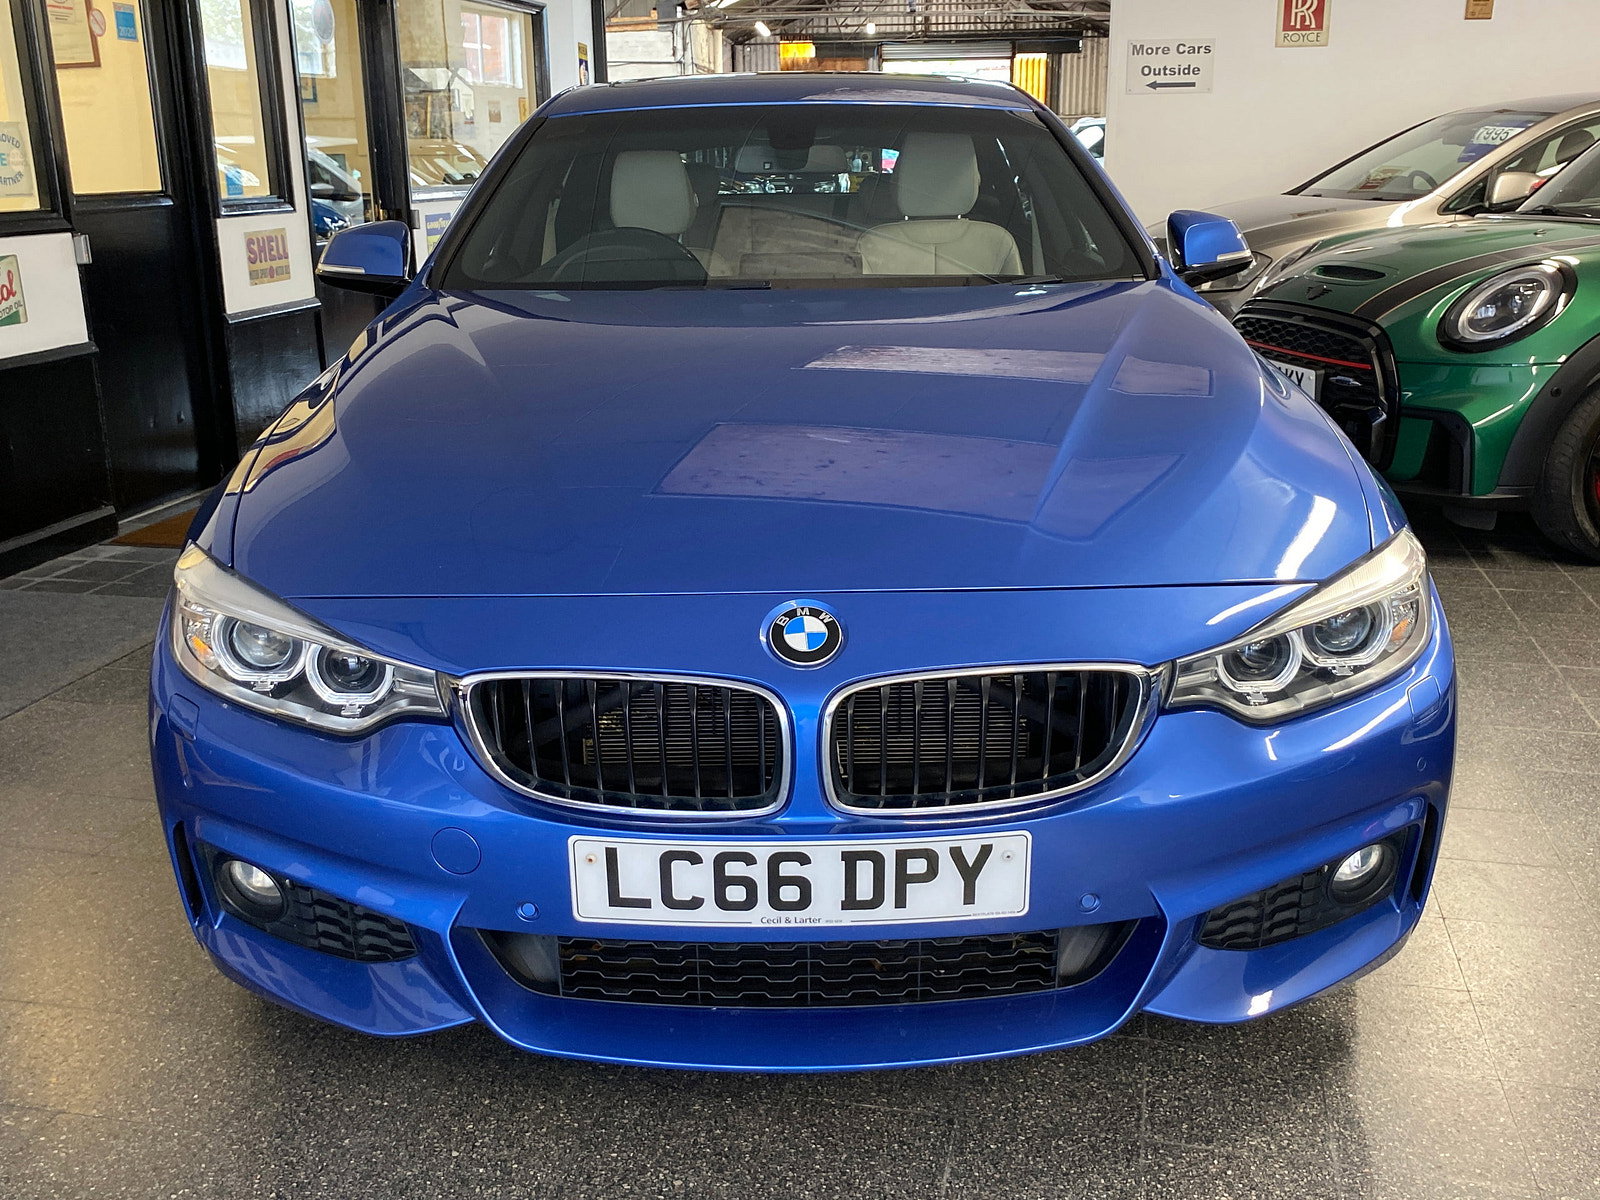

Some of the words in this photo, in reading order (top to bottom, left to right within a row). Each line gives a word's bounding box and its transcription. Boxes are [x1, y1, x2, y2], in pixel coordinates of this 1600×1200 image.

[1283, 32, 1321, 43] ROYCE
[1132, 44, 1170, 56] More
[1176, 43, 1212, 55] Cars
[1141, 64, 1201, 76] Outside
[246, 234, 289, 264] SHELL
[776, 607, 834, 627] BMW
[605, 847, 812, 911] LC66
[841, 844, 993, 911] DPY
[760, 916, 782, 924] Cecil
[784, 916, 791, 924] &
[794, 916, 822, 924] Larter
